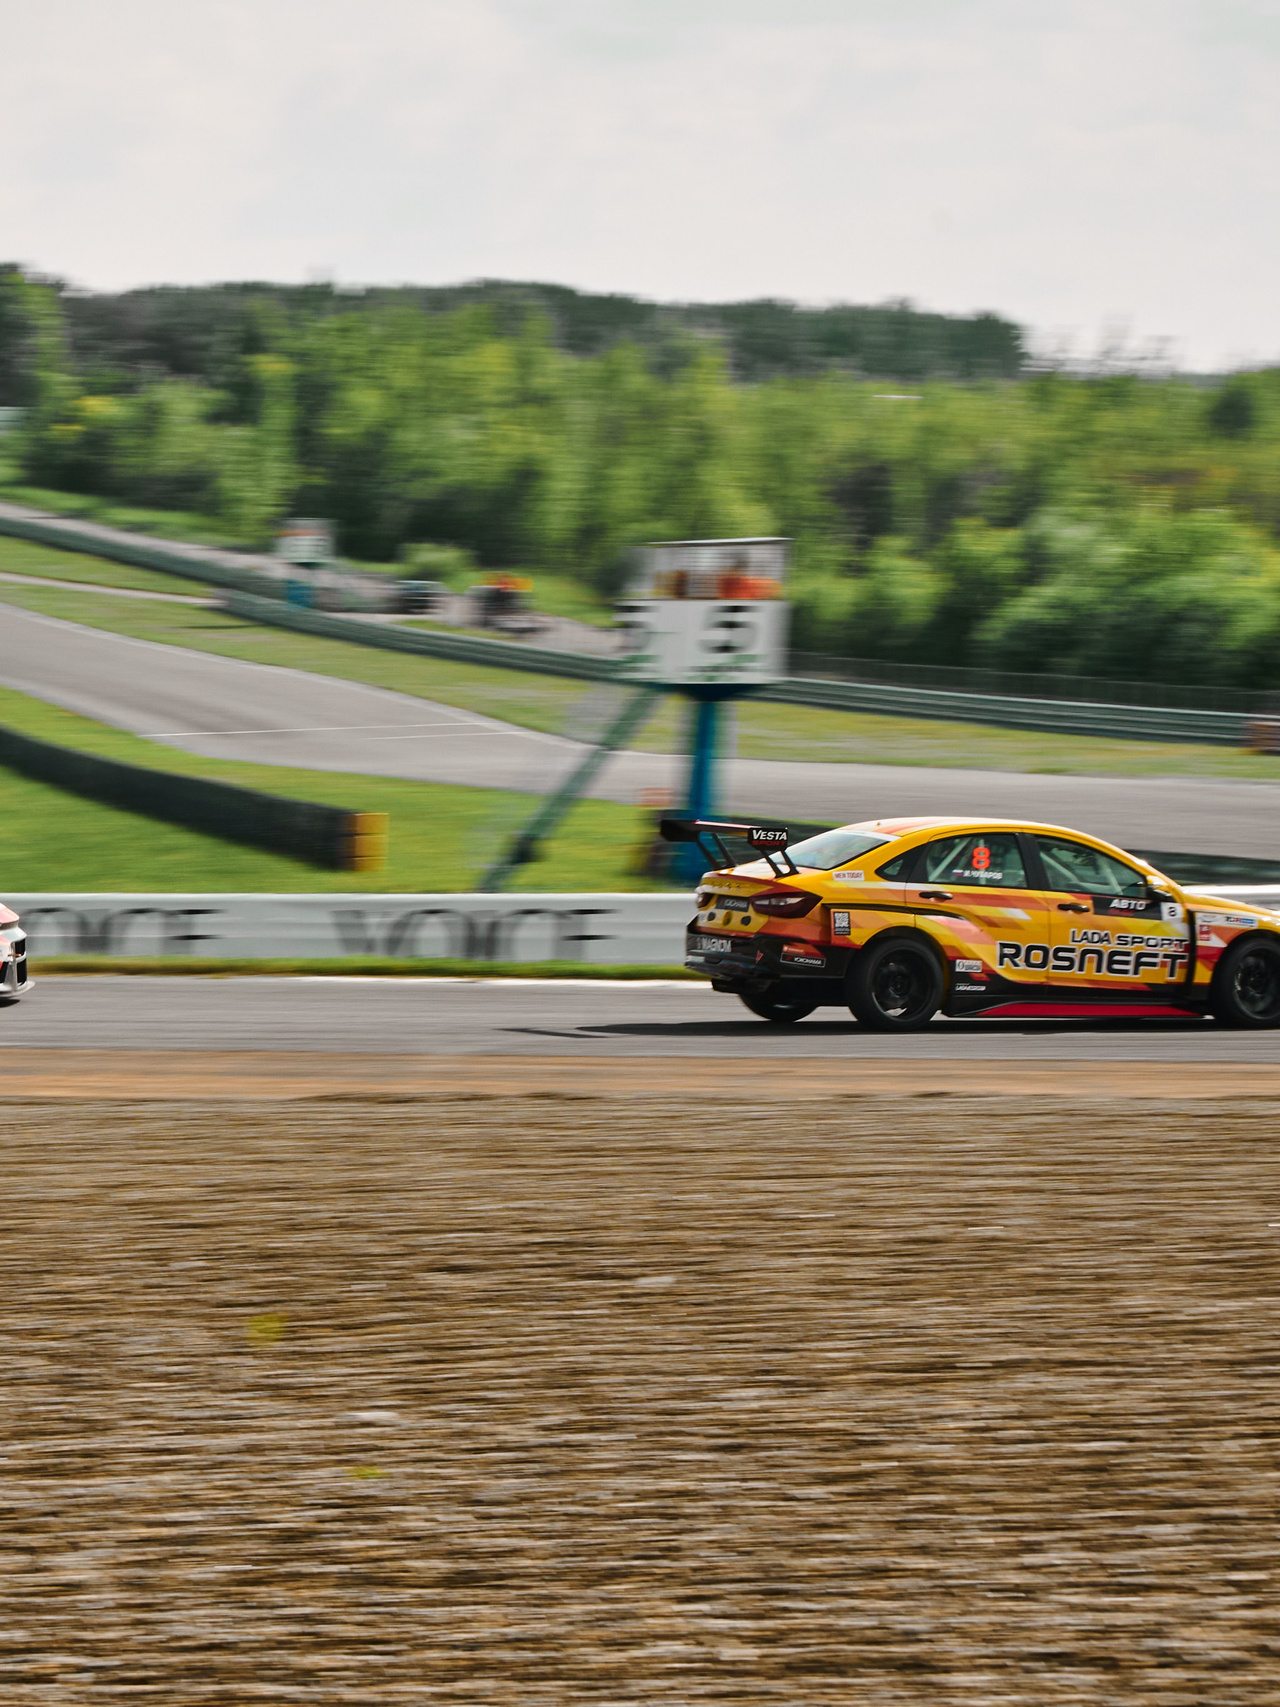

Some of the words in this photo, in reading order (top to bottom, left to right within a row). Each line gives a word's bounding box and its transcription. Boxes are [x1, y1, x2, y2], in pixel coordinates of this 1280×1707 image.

[752, 829, 788, 840] VESTA
[971, 846, 991, 870] 8
[1109, 898, 1148, 911] АВТО
[1070, 928, 1112, 946] LADA
[1115, 933, 1190, 951] SPORT
[996, 940, 1190, 980] ROSNEFT
